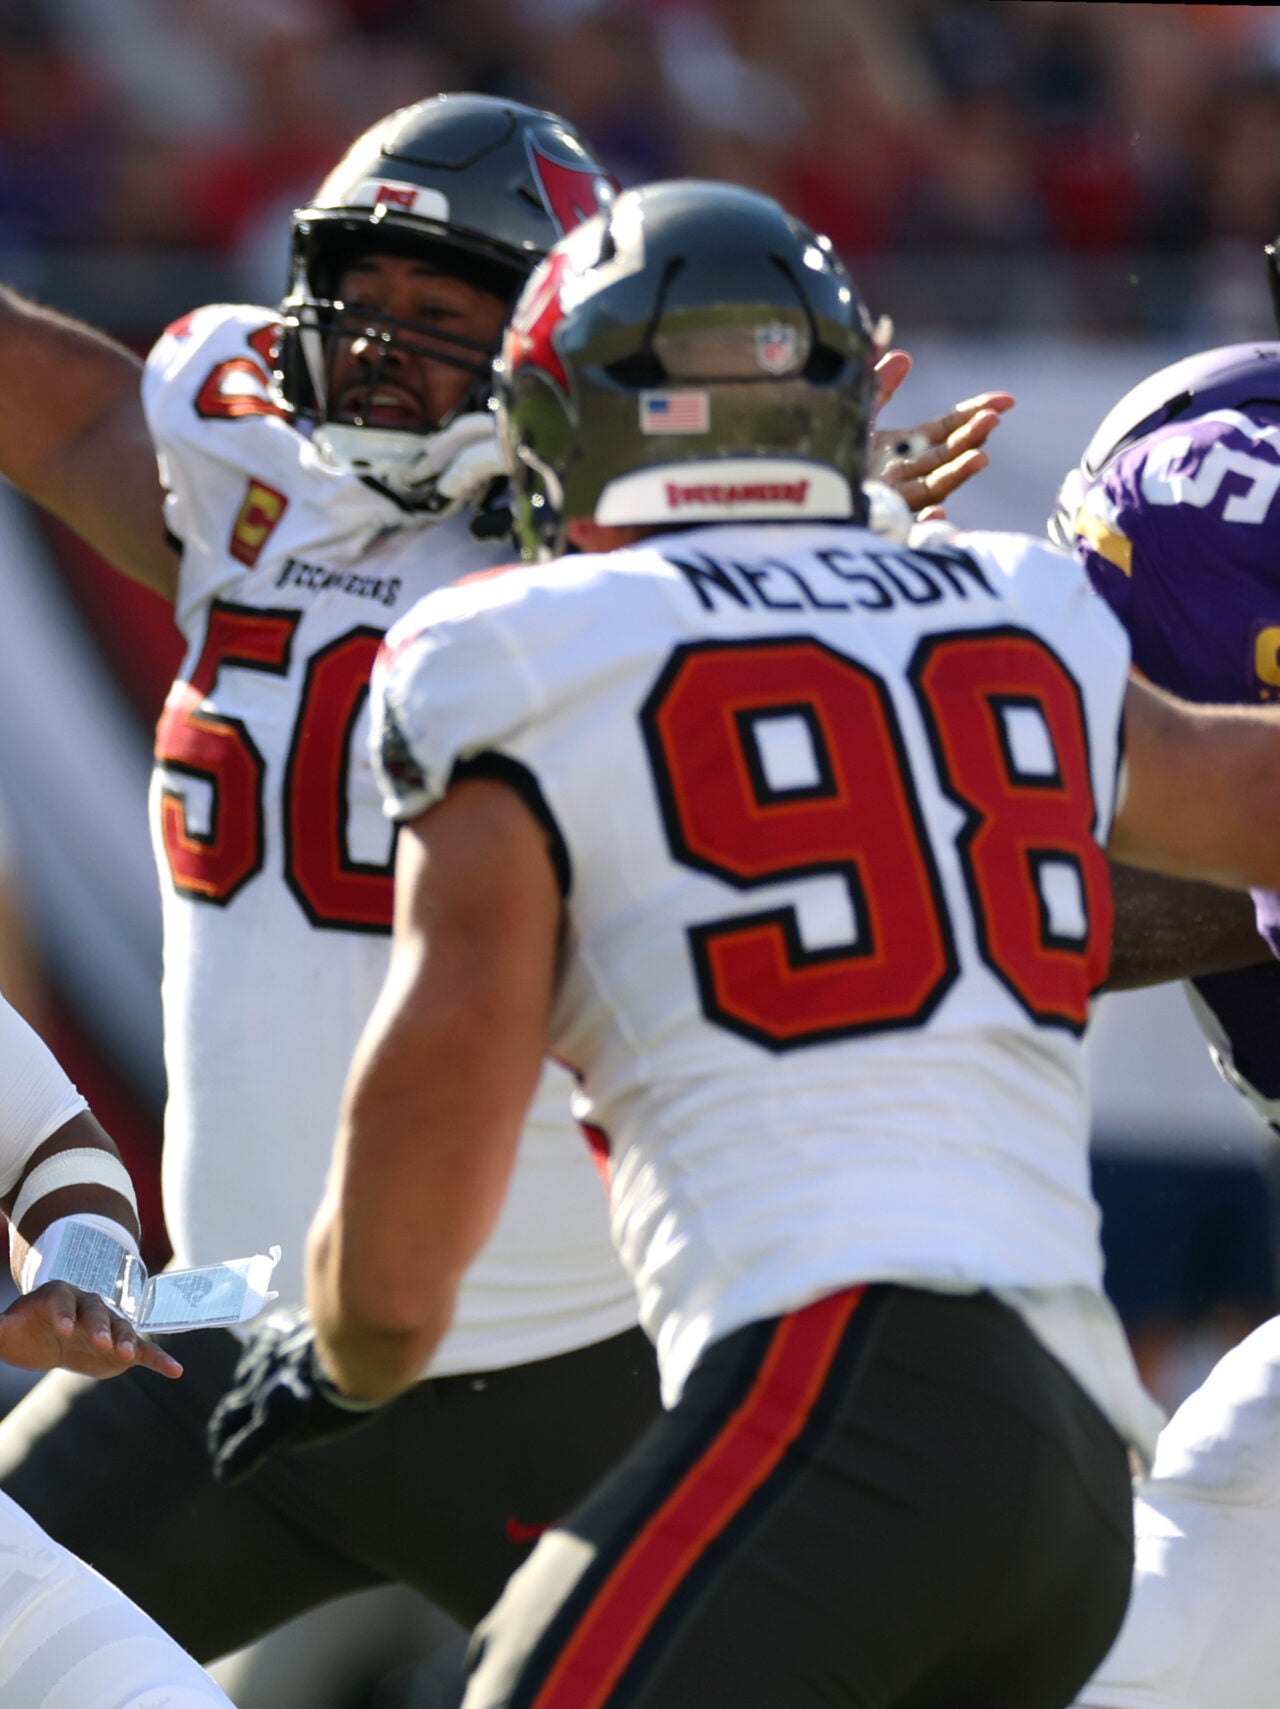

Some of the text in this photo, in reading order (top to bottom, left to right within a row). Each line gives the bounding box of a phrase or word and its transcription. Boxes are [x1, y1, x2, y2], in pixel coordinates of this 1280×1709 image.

[664, 546, 1001, 613] NELSON
[154, 599, 395, 936] 50
[638, 624, 1114, 1054] 98
